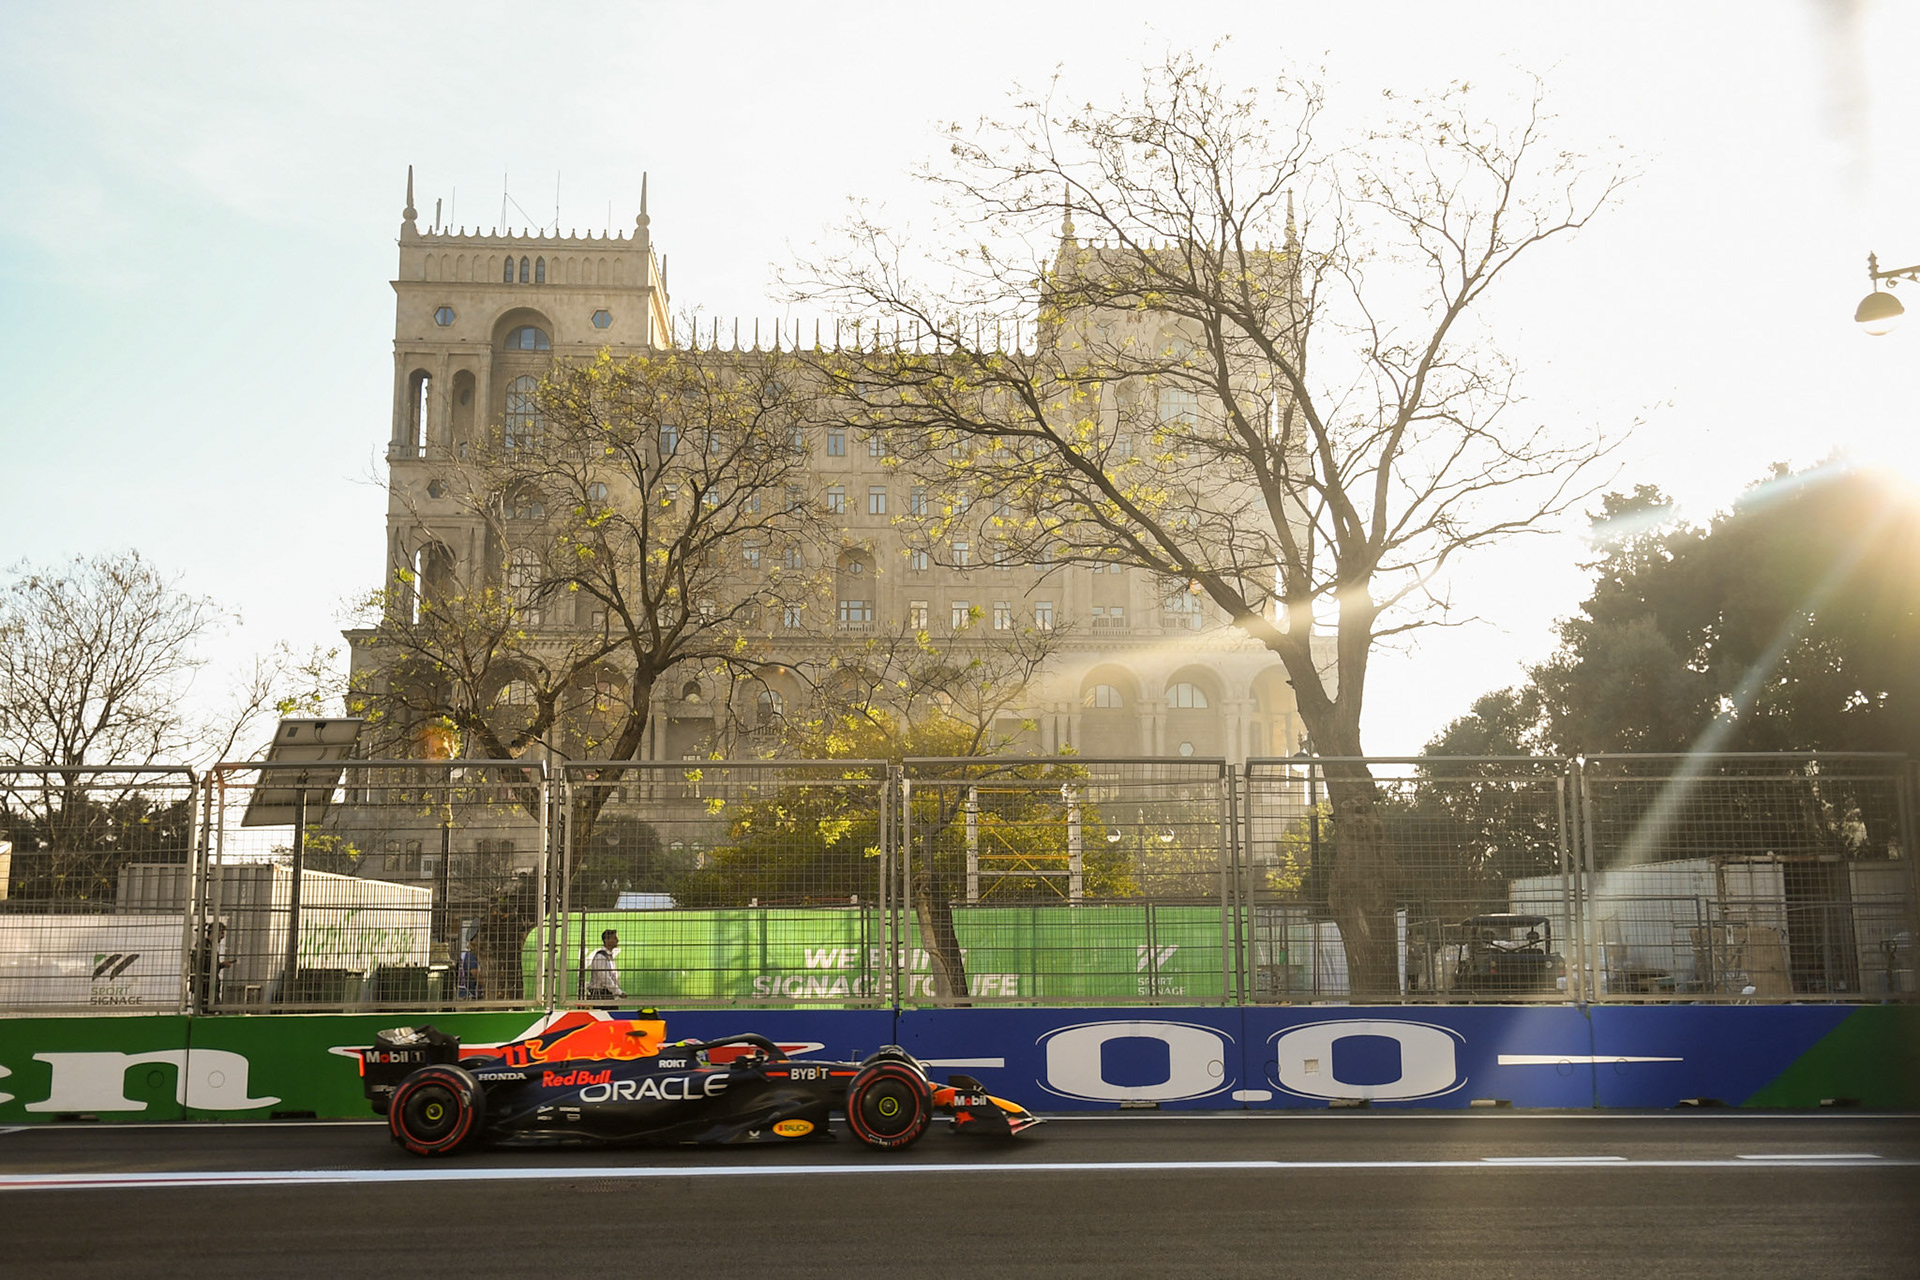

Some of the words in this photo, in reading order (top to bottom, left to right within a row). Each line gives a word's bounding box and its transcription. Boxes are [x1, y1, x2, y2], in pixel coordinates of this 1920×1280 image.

[804, 948, 858, 970] WE
[90, 986, 129, 996] SPORT
[969, 974, 1020, 997] IFE
[90, 996, 143, 1006] SIGNAGE
[366, 1050, 409, 1063] Mobil
[500, 1044, 528, 1066] 11
[658, 1059, 687, 1068] ROKT
[478, 1072, 527, 1080] HONDA
[542, 1069, 578, 1088] Red
[576, 1069, 615, 1085] Bull
[790, 1066, 829, 1080] BYBIT
[0, 1048, 282, 1113] n
[579, 1073, 730, 1103] ORACLE
[954, 1095, 987, 1106] Mobil
[783, 1122, 810, 1132] RAUCH
